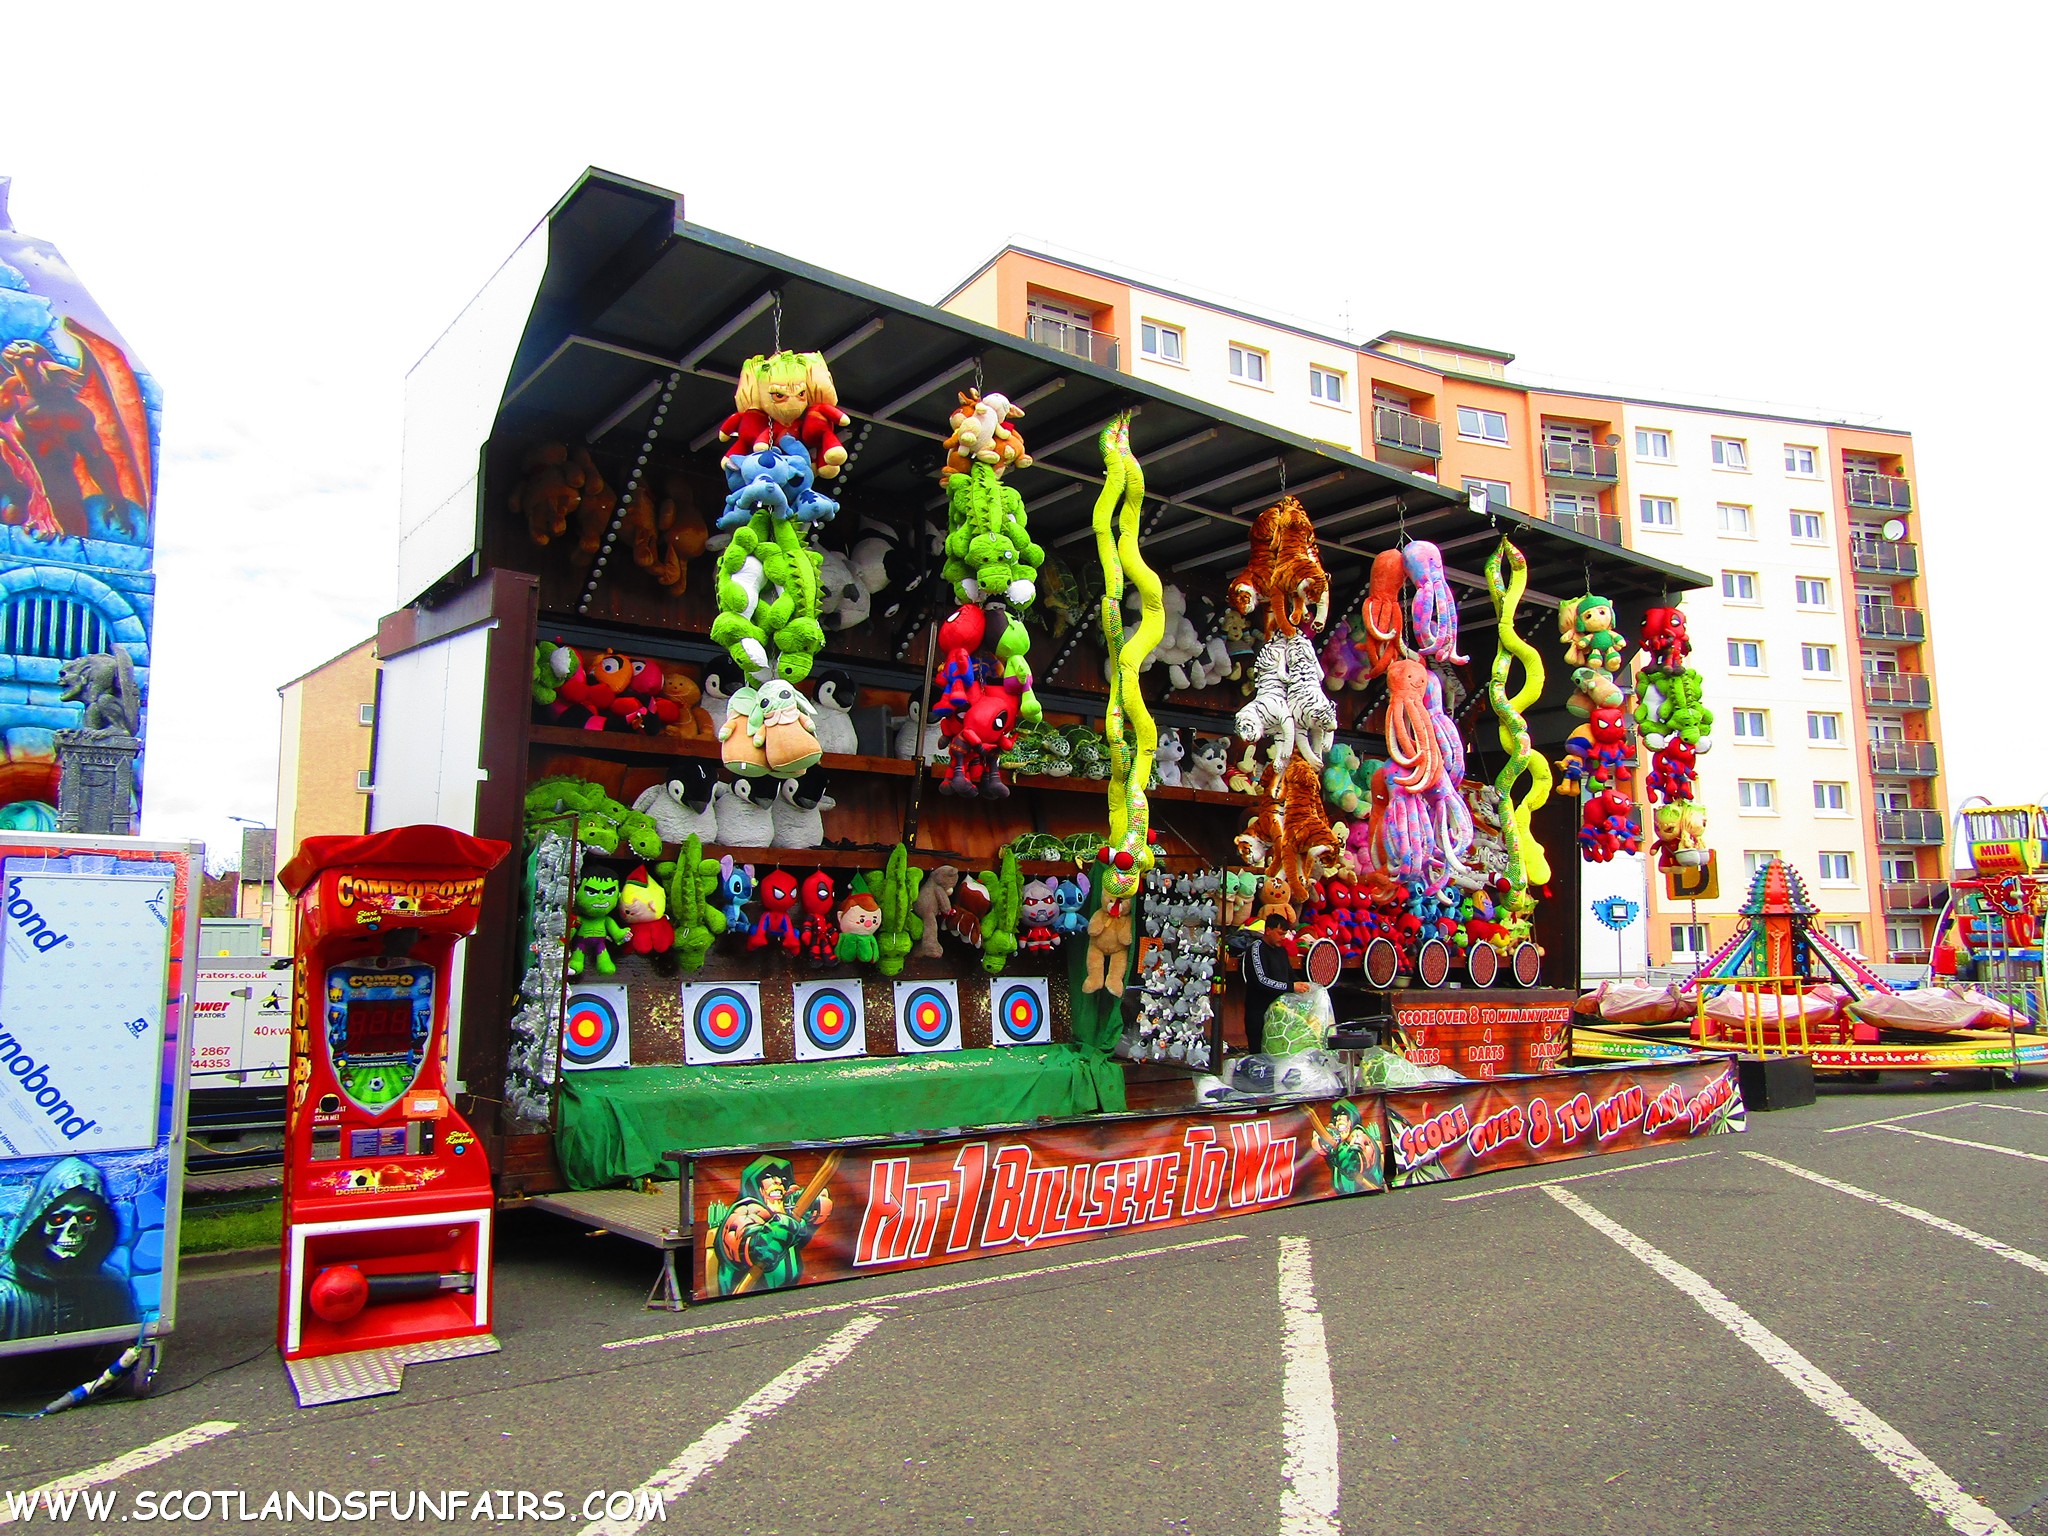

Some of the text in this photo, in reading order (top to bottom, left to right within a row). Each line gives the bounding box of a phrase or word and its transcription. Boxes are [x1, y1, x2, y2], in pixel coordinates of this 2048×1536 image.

[1981, 844, 2010, 856] MINI
[1977, 857, 2020, 868] WHEEL
[1674, 864, 1710, 896] D
[349, 974, 414, 987] COMBO
[1398, 1006, 1570, 1026] SCORE OVER 8 TO WIN ANY PRIZE
[254, 1026, 269, 1036] 40
[1416, 1030, 1425, 1047] 3
[1483, 1028, 1492, 1043] 4
[1543, 1026, 1552, 1041] 5
[201, 1046, 231, 1056] 2867
[1404, 1048, 1440, 1065] DARTS
[1468, 1046, 1505, 1061] DARTS
[192, 1058, 231, 1068] 44353
[314, 1114, 329, 1122] SCAN
[1399, 1071, 1733, 1170] SCORE OVER 8 TO WIN ANY PRIZE
[335, 1184, 419, 1196] DOUBLE COMBAT
[851, 1119, 1298, 1267] HIT 1 BULLSEYE TO WIN
